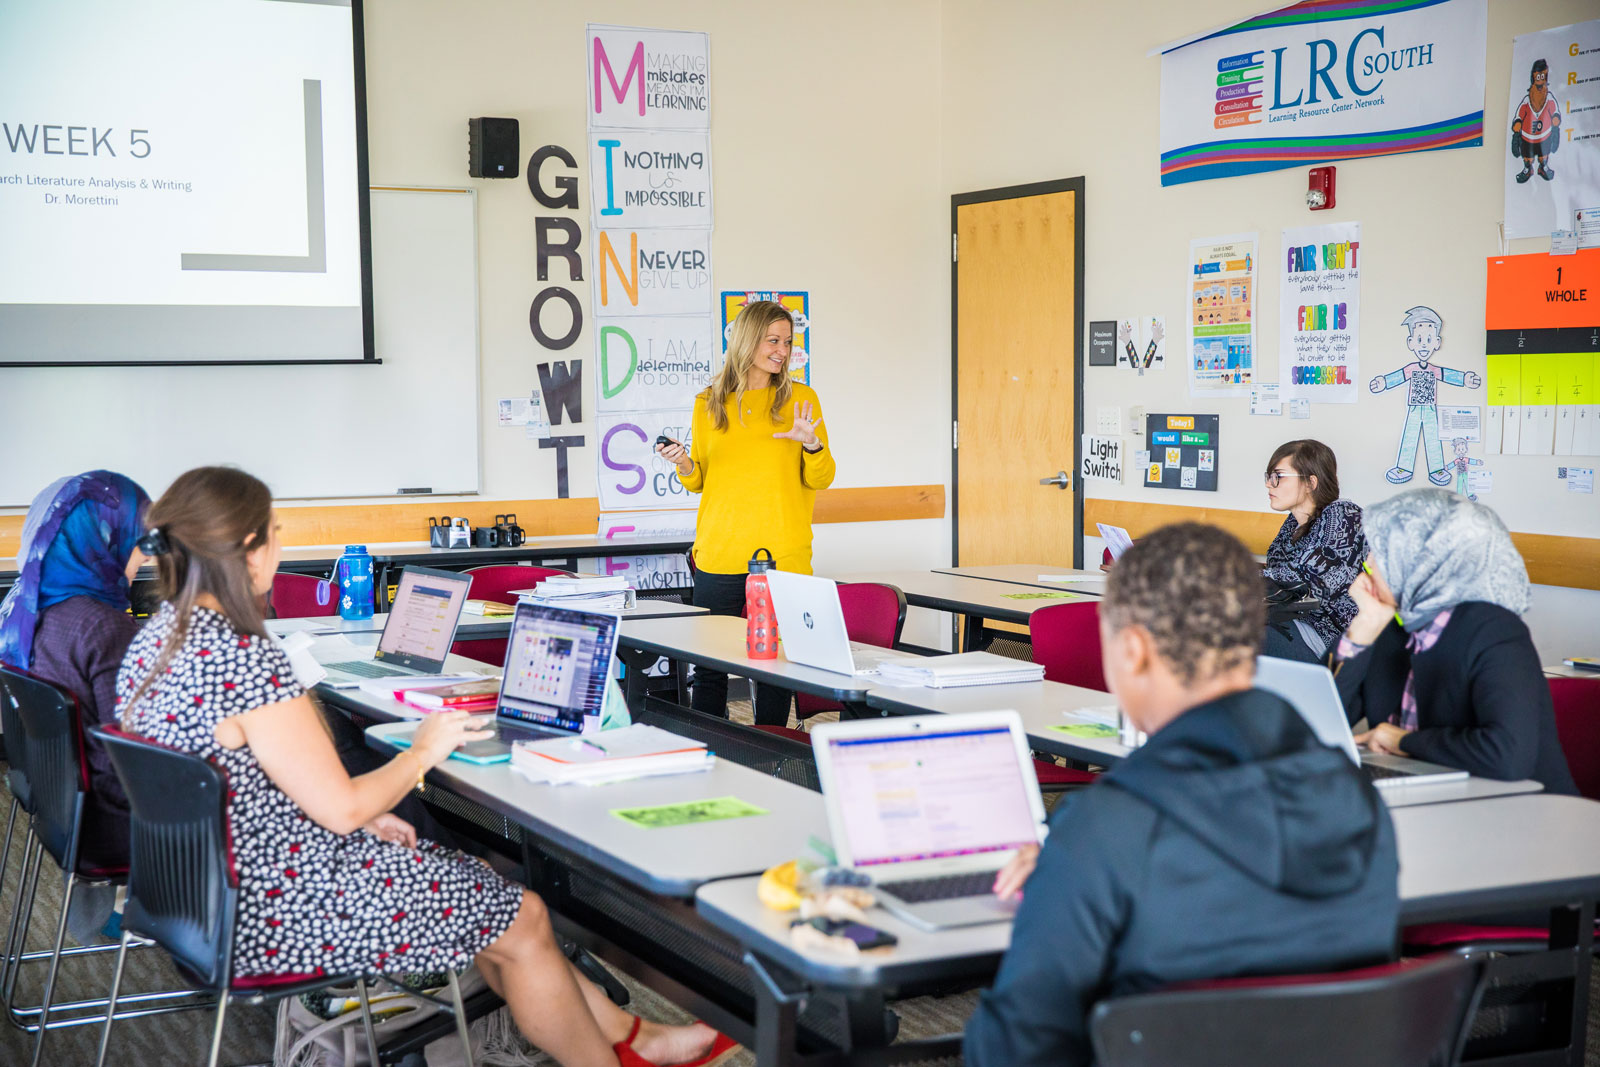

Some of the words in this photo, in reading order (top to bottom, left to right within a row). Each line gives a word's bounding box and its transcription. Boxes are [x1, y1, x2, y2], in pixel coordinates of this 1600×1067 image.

[647, 53, 706, 72] MAKING
[1221, 58, 1249, 69] Information
[1269, 25, 1385, 111] LRC
[1363, 43, 1434, 76] SOUTH
[647, 68, 706, 85] mistakes
[1221, 74, 1241, 84] Training
[647, 82, 687, 96] MEANS
[689, 85, 705, 96] I'M
[1220, 87, 1246, 97] Production
[647, 93, 707, 111] LEARNING
[1219, 101, 1249, 112] Consultation
[1268, 111, 1297, 123] Learning
[1299, 107, 1330, 118] Resource
[1331, 103, 1353, 113] Center
[1354, 95, 1385, 109] Network
[1218, 115, 1245, 126] Circulation
[3, 123, 116, 157] WEEK
[130, 129, 151, 158] 5
[27, 174, 85, 187] Literature
[88, 176, 136, 190] Analysis
[139, 179, 148, 189] &
[152, 179, 193, 192] Writing
[45, 193, 61, 204] Dr.
[65, 194, 119, 206] Morettini
[625, 189, 706, 208] IMPOSSIBLE
[640, 249, 706, 270] NEVER
[1287, 244, 1317, 273] FAIR
[1322, 240, 1359, 271] ISN'T
[639, 270, 680, 289] GIVE
[686, 271, 709, 290] UP
[1288, 272, 1320, 283] everybody
[1323, 271, 1345, 283] getting
[1348, 269, 1359, 280] the
[1556, 266, 1562, 285] 1
[1300, 284, 1315, 293] same
[1545, 289, 1587, 302] WHOLE
[1298, 303, 1328, 331] FAIR
[1333, 302, 1347, 330] IS
[1093, 339, 1113, 347] Occupancy
[1294, 333, 1326, 344] everybody
[1329, 333, 1351, 344] getting
[647, 338, 653, 360] I
[664, 339, 697, 361] AM
[1296, 343, 1313, 352] what
[1316, 343, 1331, 353] they
[636, 359, 710, 372] determined
[1327, 354, 1336, 362] to
[635, 373, 655, 385] TO
[659, 373, 680, 386] DO
[683, 373, 711, 386] THIS
[1170, 419, 1188, 428] Today
[1157, 434, 1175, 442] would
[1182, 434, 1194, 442] like
[1090, 438, 1118, 460] Light
[1084, 458, 1121, 481] Switch
[635, 556, 668, 573] BUT
[637, 571, 693, 590] WORTH
